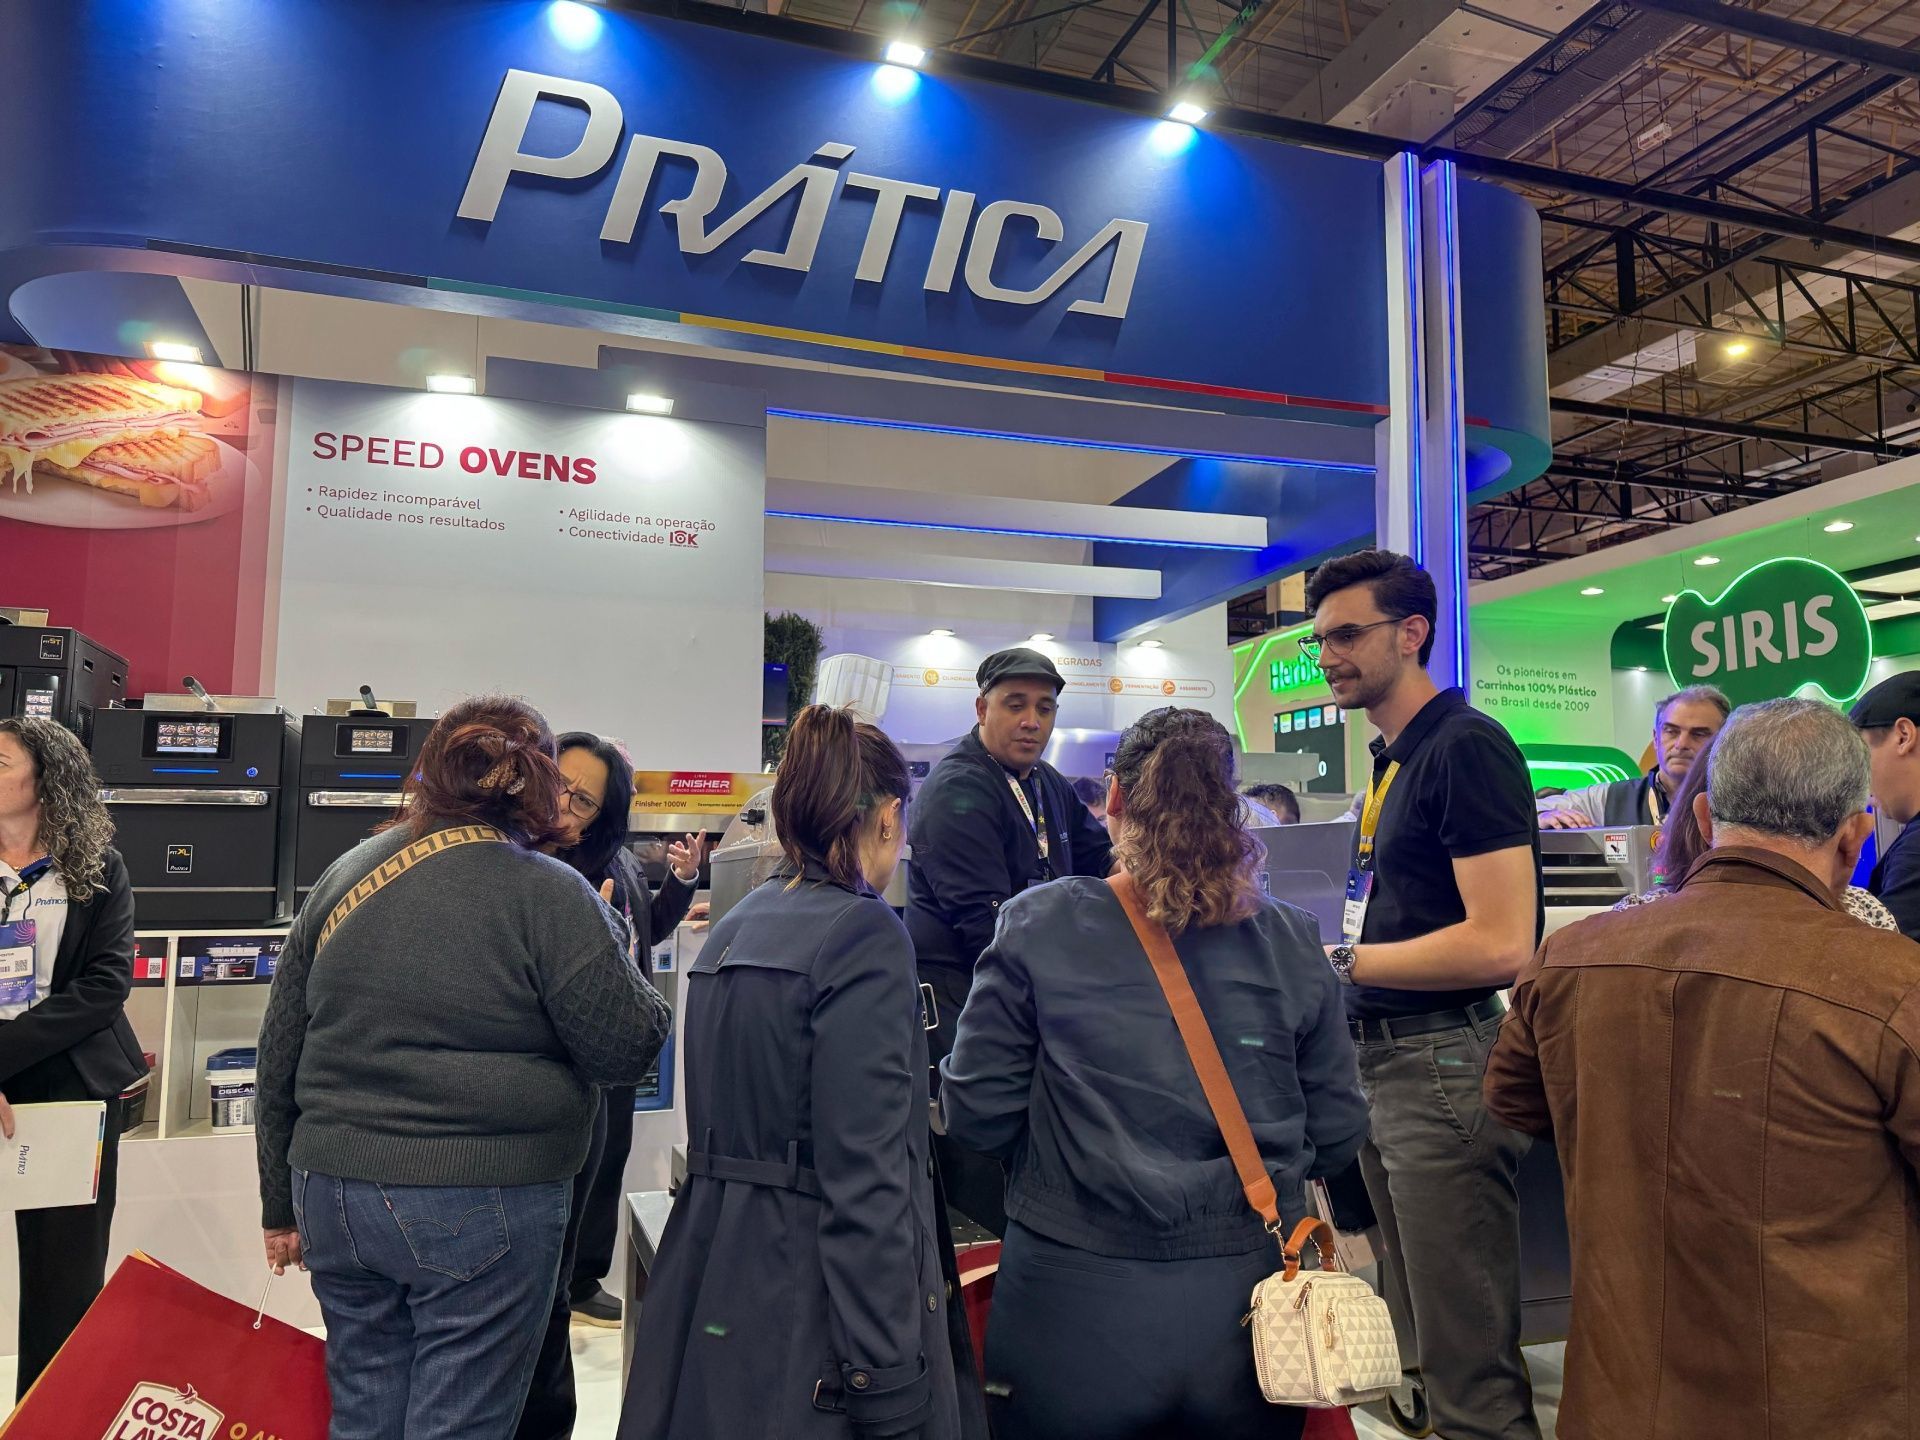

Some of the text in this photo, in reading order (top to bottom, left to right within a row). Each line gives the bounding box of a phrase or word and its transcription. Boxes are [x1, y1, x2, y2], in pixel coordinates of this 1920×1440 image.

[312, 432, 597, 485] SPEED OVENS
[319, 485, 481, 510] Rapidez incomparável
[317, 504, 505, 531] Qualidade nos resultados
[569, 508, 716, 532] Agilidade na operação
[569, 526, 665, 545] Conectividade
[1691, 595, 1838, 678] SIRIS
[1056, 656, 1102, 667] EGRADAS
[1496, 665, 1577, 680] Os pioneiros em
[1476, 680, 1597, 698] Carrinhos 100% Plástico
[1484, 696, 1590, 712] no Brasil desde 2009
[670, 779, 730, 789] FINISHER
[635, 800, 662, 808] Finisher
[177, 848, 190, 856] XL
[131, 1397, 206, 1440] COSTA
